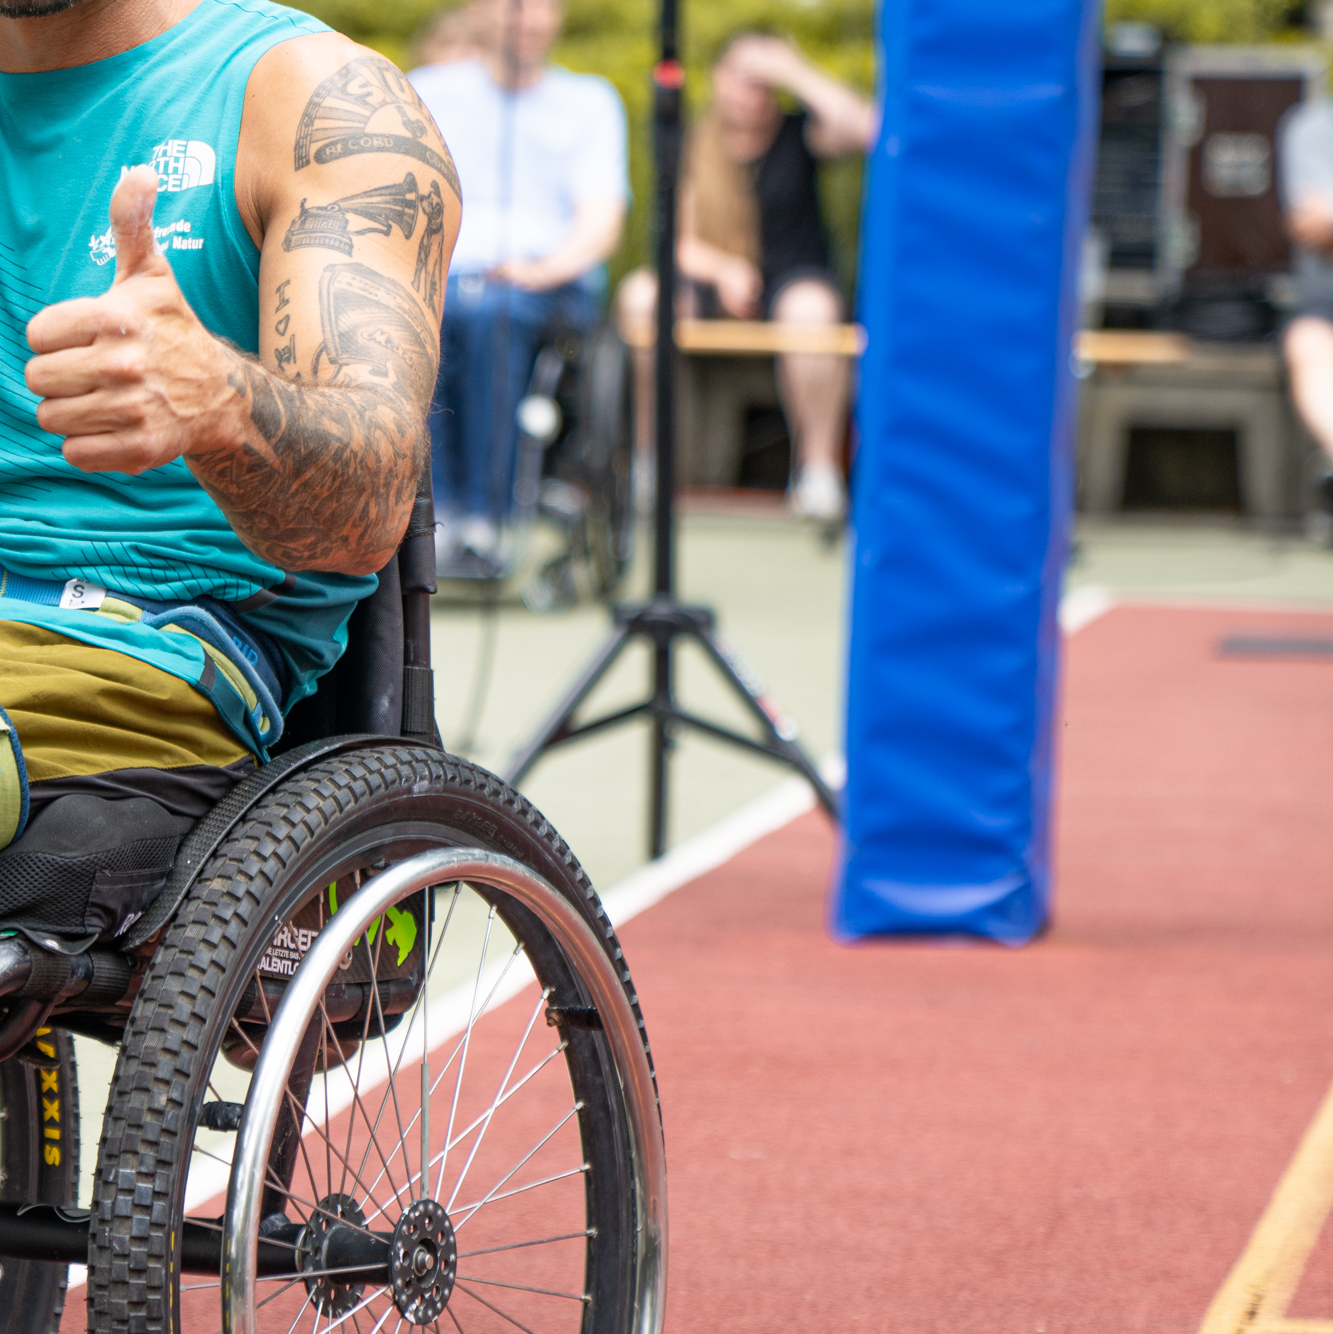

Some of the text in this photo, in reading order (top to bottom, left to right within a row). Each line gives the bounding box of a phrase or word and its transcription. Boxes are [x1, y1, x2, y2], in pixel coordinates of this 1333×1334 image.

[341, 66, 423, 111] SU
[172, 235, 204, 250] Natur
[71, 584, 85, 599] S
[273, 948, 290, 959] LETZTE
[257, 956, 300, 976] ALENTL
[36, 1027, 61, 1167] XXIS
